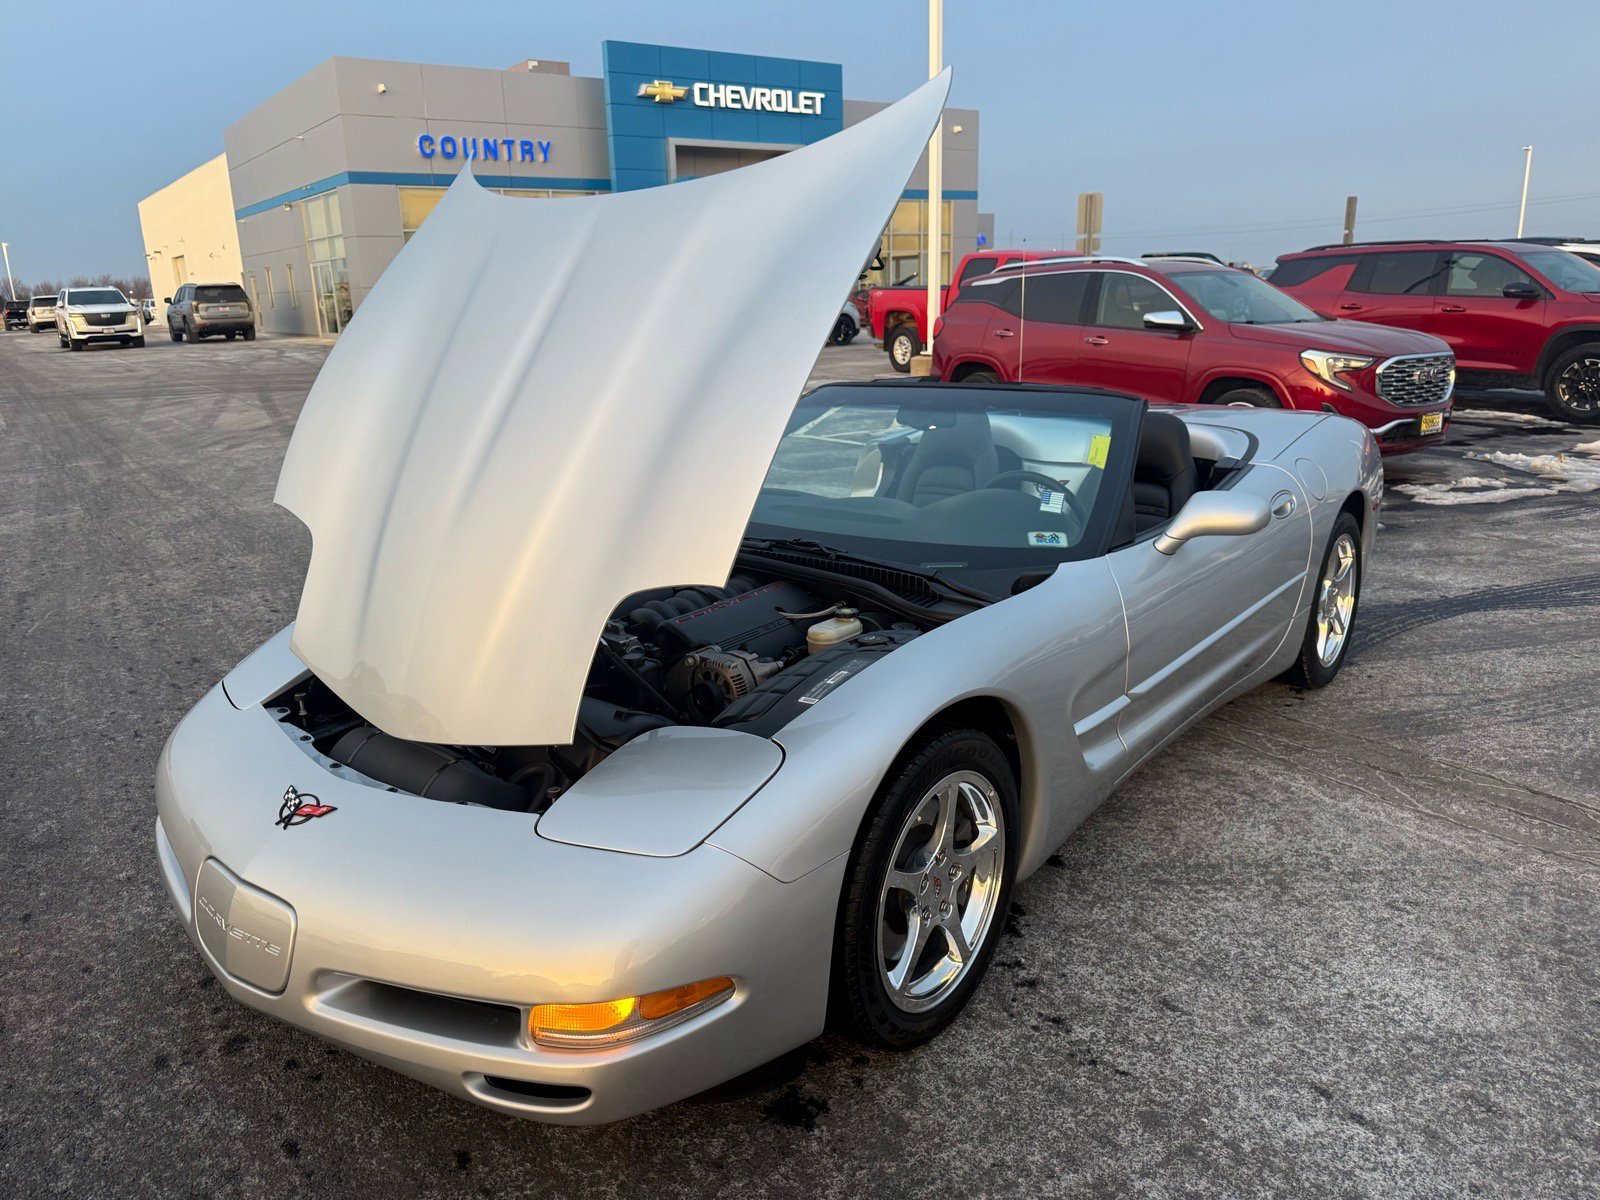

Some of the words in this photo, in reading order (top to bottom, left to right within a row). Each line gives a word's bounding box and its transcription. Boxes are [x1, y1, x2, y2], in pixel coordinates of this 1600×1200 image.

[693, 82, 825, 115] CHEVROLET
[418, 134, 551, 163] COUNTRY
[199, 896, 281, 957] CORVETTE
